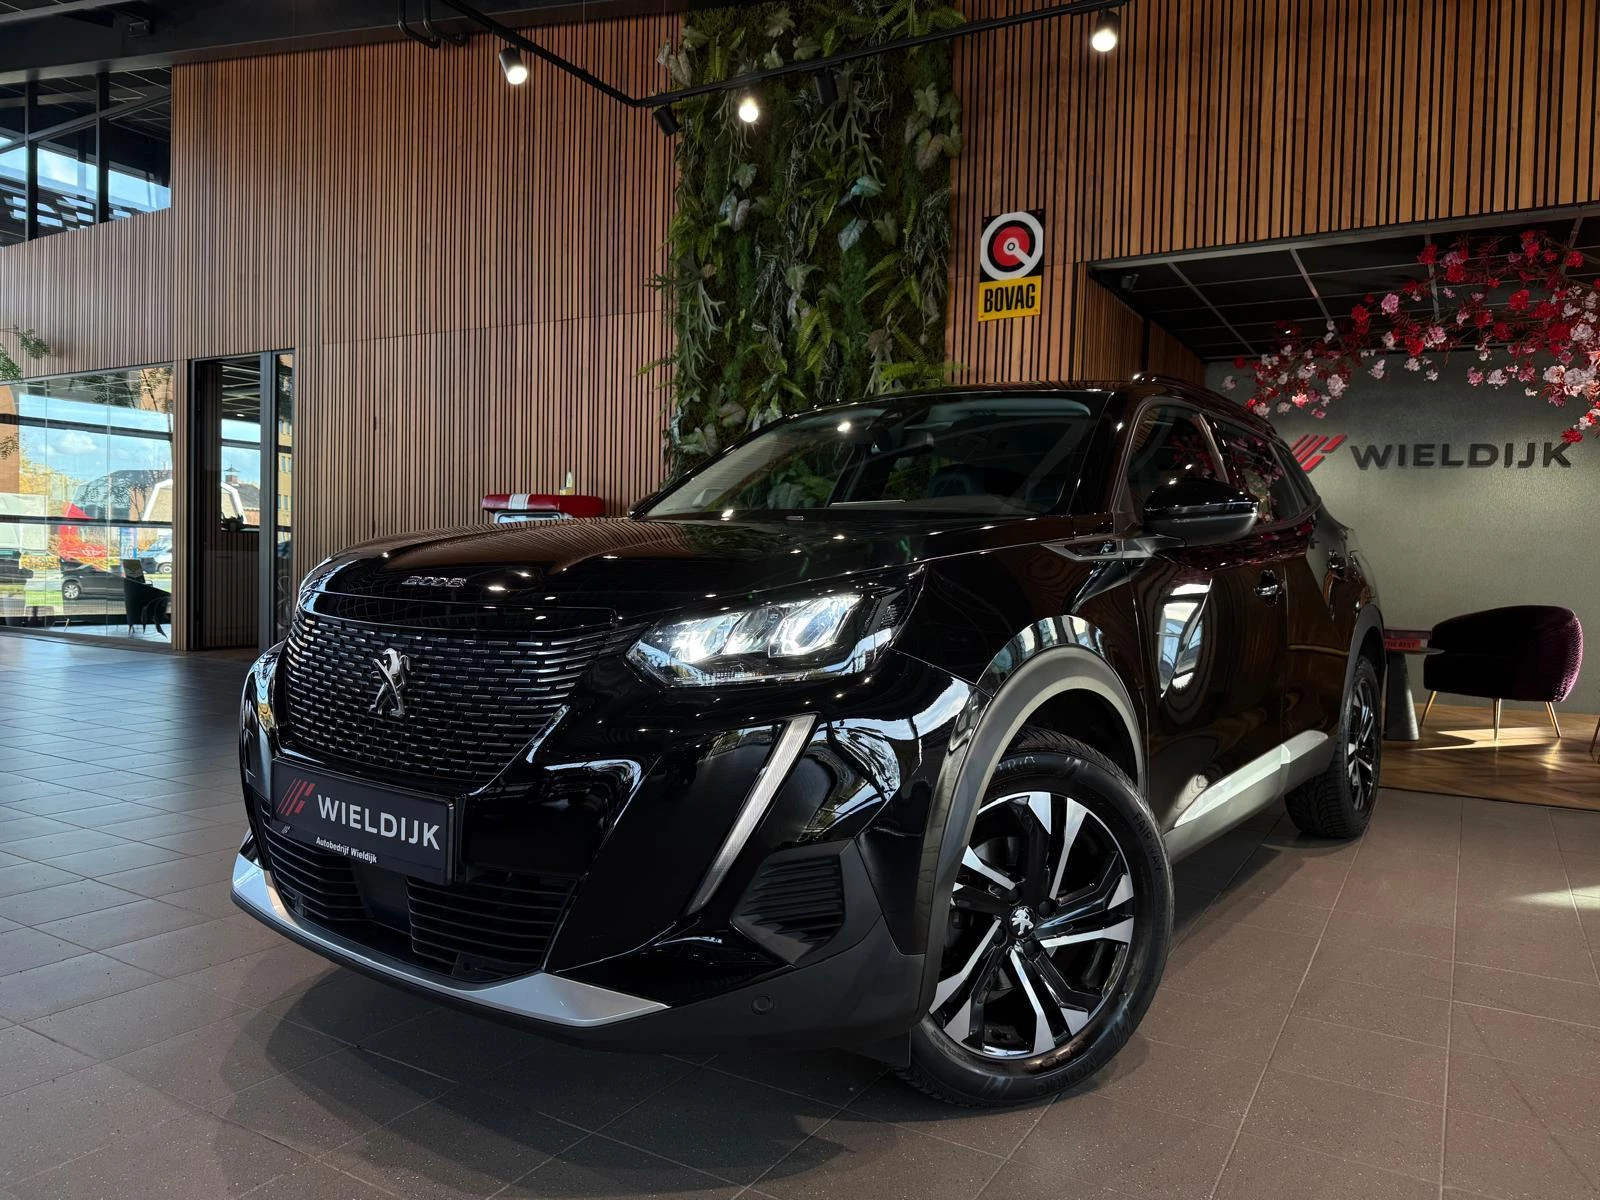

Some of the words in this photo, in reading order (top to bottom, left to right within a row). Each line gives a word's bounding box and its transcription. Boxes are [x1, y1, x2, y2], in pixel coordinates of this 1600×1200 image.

[984, 283, 1036, 314] BOVAG
[1350, 441, 1573, 471] WIELDIJK
[317, 794, 441, 851] WIELDIJK
[316, 836, 350, 856] Autobedrijf
[350, 847, 378, 864] Wieldijk
